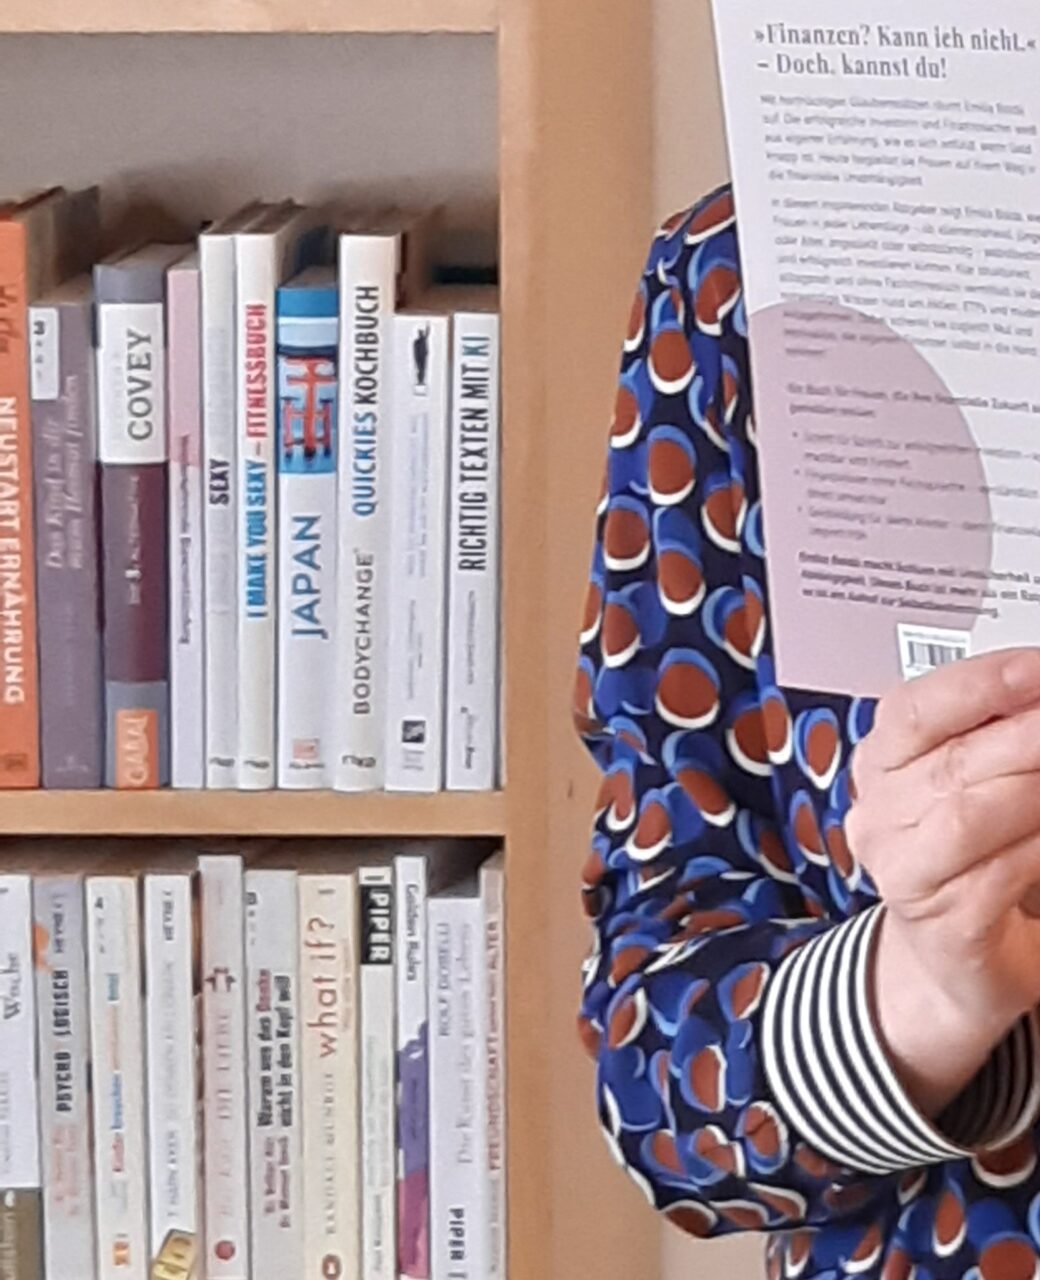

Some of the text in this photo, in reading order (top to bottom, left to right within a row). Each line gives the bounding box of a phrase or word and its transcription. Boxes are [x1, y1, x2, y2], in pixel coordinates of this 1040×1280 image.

[842, 53, 909, 77] kannst
[878, 26, 928, 49] Kann
[934, 26, 965, 50] ich
[246, 304, 268, 439] FITNESSBUCH
[353, 286, 380, 405] KOCHBUCH
[461, 336, 491, 357] KI
[461, 363, 490, 400] MIT
[127, 329, 153, 441] COVEY
[209, 458, 230, 506] SEXY
[353, 411, 379, 516] QUICKIES
[459, 408, 489, 483] TEXTEN
[246, 459, 268, 506] SEXY
[458, 491, 488, 572] RICHTIG
[291, 515, 329, 640] JAPAN
[368, 890, 391, 962] PIPER
[304, 917, 338, 1058] what if?
[448, 1207, 466, 1261] PIPER
